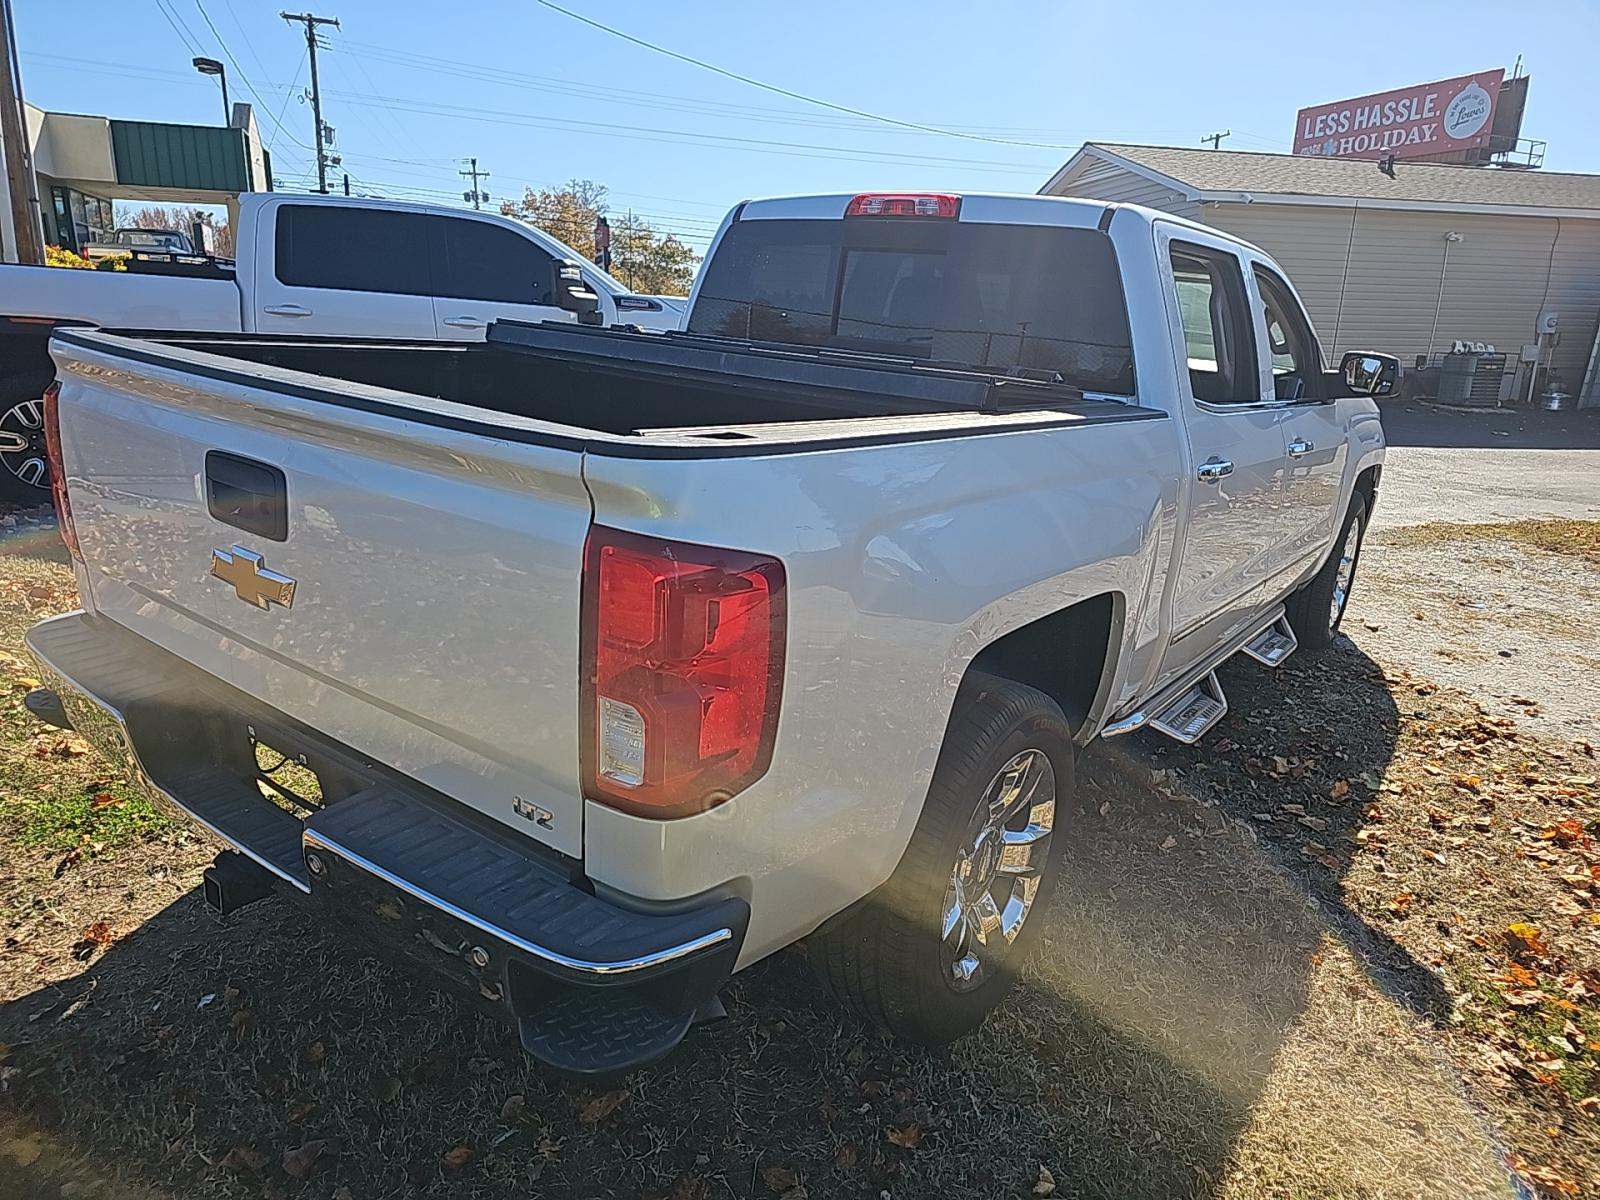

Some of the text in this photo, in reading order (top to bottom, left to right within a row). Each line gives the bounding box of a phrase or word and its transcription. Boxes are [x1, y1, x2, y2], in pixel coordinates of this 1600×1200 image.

[1303, 110, 1351, 140] LESS
[1354, 94, 1440, 131] HASSLE.
[1339, 124, 1438, 155] HOLIDAY.
[512, 795, 554, 830] LTZ
